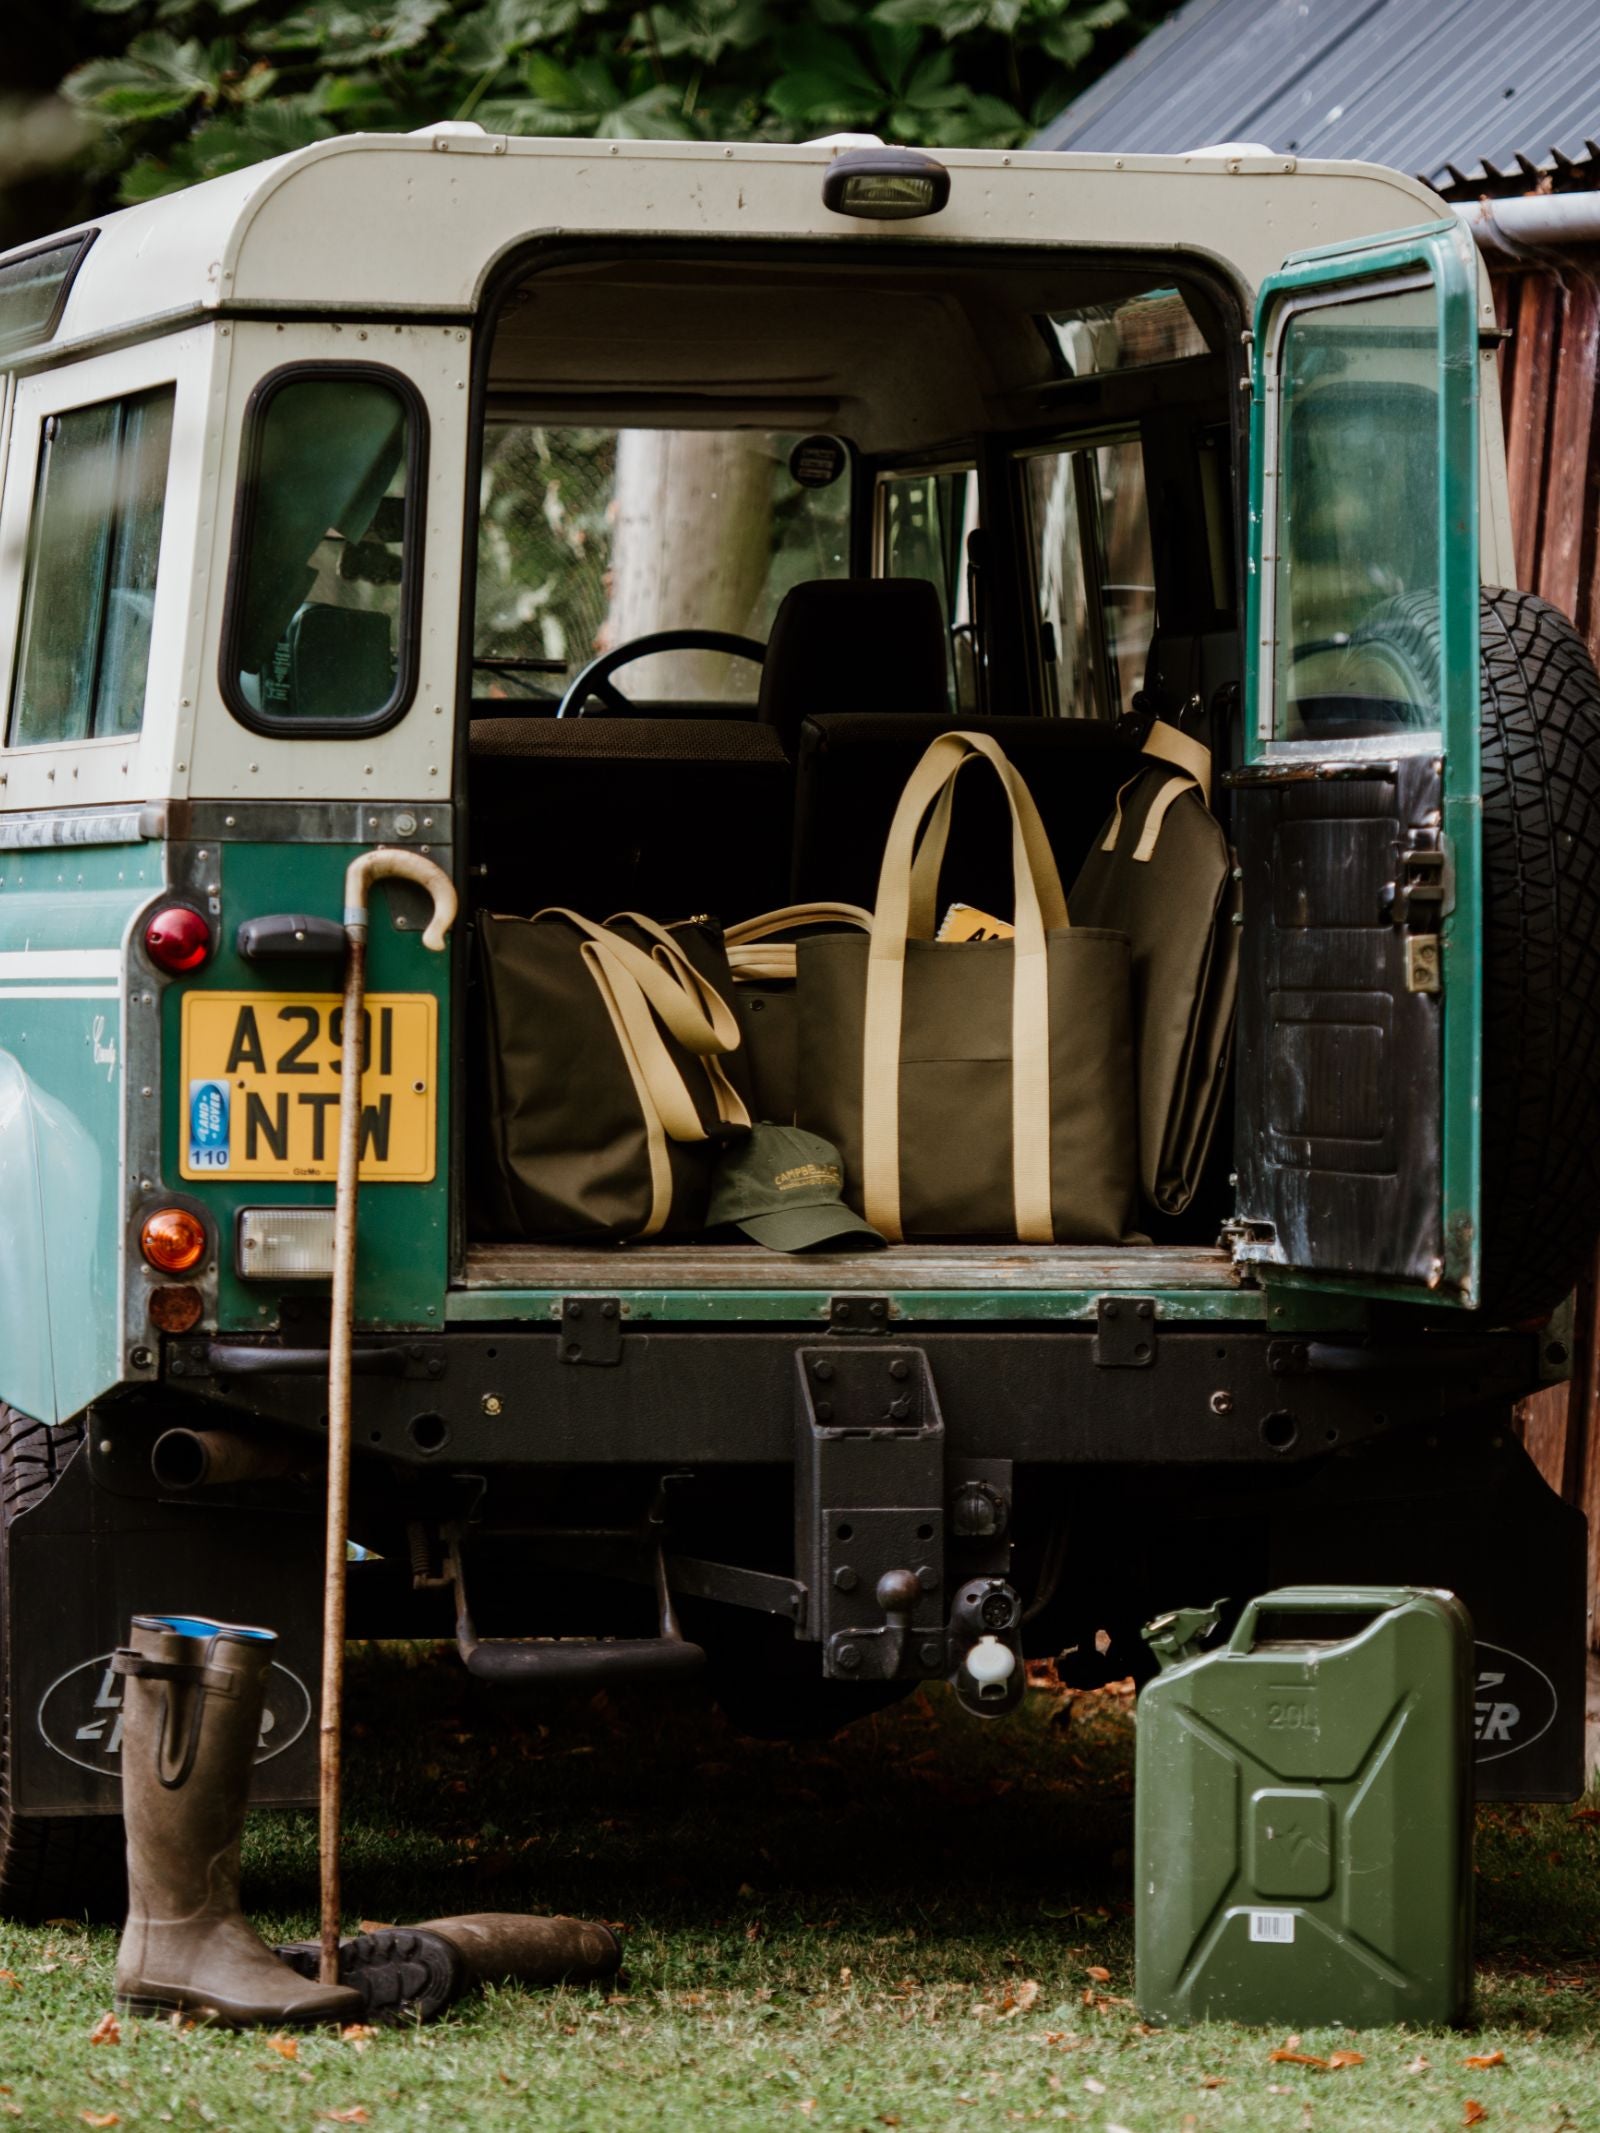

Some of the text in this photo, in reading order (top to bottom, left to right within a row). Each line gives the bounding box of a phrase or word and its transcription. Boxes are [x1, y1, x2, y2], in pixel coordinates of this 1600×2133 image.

[225, 1005, 393, 1076] A291
[192, 1150, 228, 1165] 110
[245, 1092, 392, 1162] NTW
